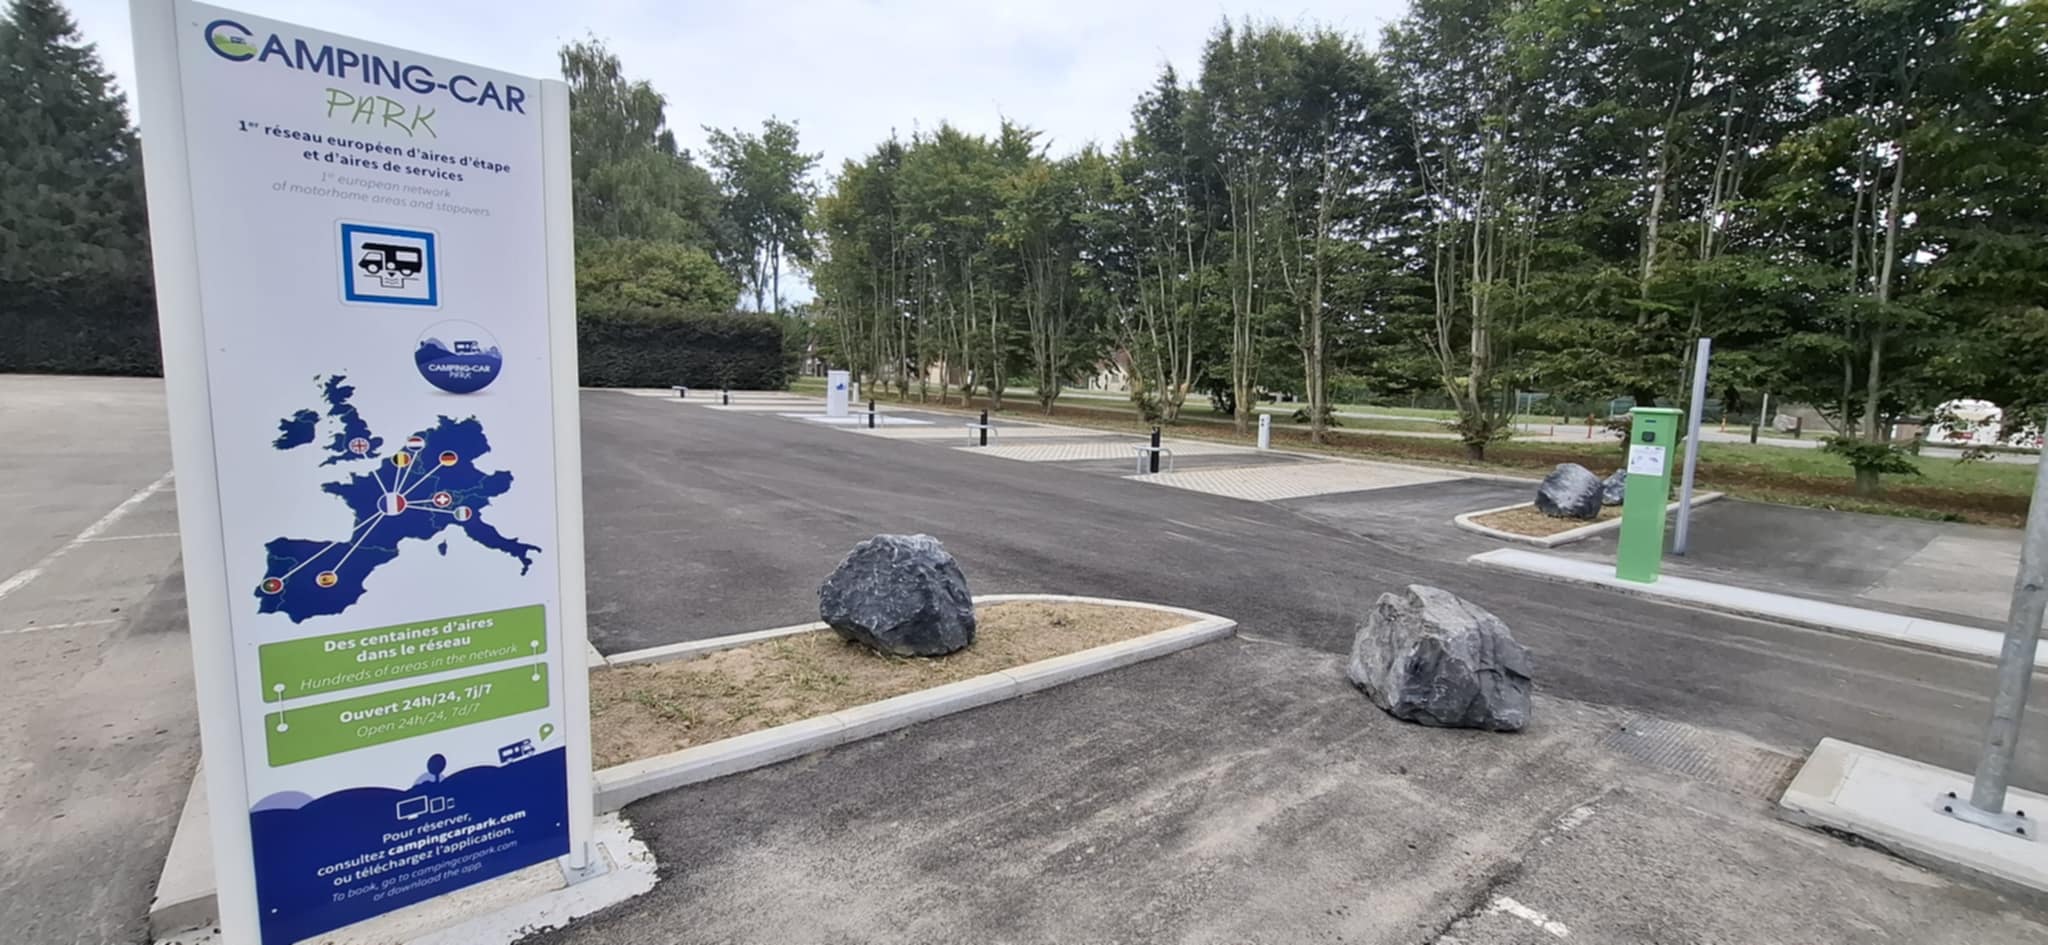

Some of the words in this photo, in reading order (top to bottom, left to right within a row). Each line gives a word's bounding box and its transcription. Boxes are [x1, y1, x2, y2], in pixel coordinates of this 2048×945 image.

[204, 19, 526, 115] CAMPING-CAR
[325, 87, 437, 138] PARK
[264, 124, 323, 144] réseau
[327, 135, 403, 157] européen
[406, 147, 456, 165] d'aires
[459, 156, 511, 174] d'étape
[303, 149, 320, 161] et
[324, 151, 379, 170] d'aires
[382, 161, 401, 173] de
[405, 165, 464, 182] services
[272, 180, 287, 192] of
[289, 182, 369, 202] motorhome
[371, 195, 408, 208] areas
[409, 199, 434, 210] and
[436, 202, 491, 217] stopovers
[337, 174, 400, 192] european
[402, 184, 451, 199] network
[428, 363, 491, 373] CAMPING-CAR
[324, 640, 356, 652] Des
[360, 627, 439, 647] centaines
[443, 618, 494, 634] d'aires
[356, 647, 398, 662] dans
[400, 643, 416, 655] le
[419, 636, 471, 652] réseau
[300, 668, 371, 691] Hundreds
[374, 664, 389, 677] of
[391, 661, 429, 674] areas
[431, 657, 443, 668] in
[446, 653, 467, 665] the
[469, 643, 518, 661] network
[339, 703, 399, 723] Ouvert
[402, 691, 462, 711] 24h/24,
[464, 683, 493, 699] 7j/7
[356, 721, 395, 738] Open
[399, 711, 447, 730] 24h/24,
[451, 702, 480, 718] 7d/7
[317, 850, 386, 876] consultez
[388, 810, 526, 856] campingcarpark.com
[382, 828, 415, 844] Pour
[417, 813, 472, 834] réserver,
[332, 893, 346, 902] To
[347, 882, 379, 898] book,
[381, 877, 397, 890] go
[398, 872, 410, 882] to
[411, 840, 518, 878] campingcarpark.com
[333, 875, 353, 886] ou
[355, 850, 433, 880] téléchargez
[435, 827, 515, 855] l'application.
[373, 892, 386, 902] or
[387, 872, 442, 897] download
[443, 867, 460, 879] the
